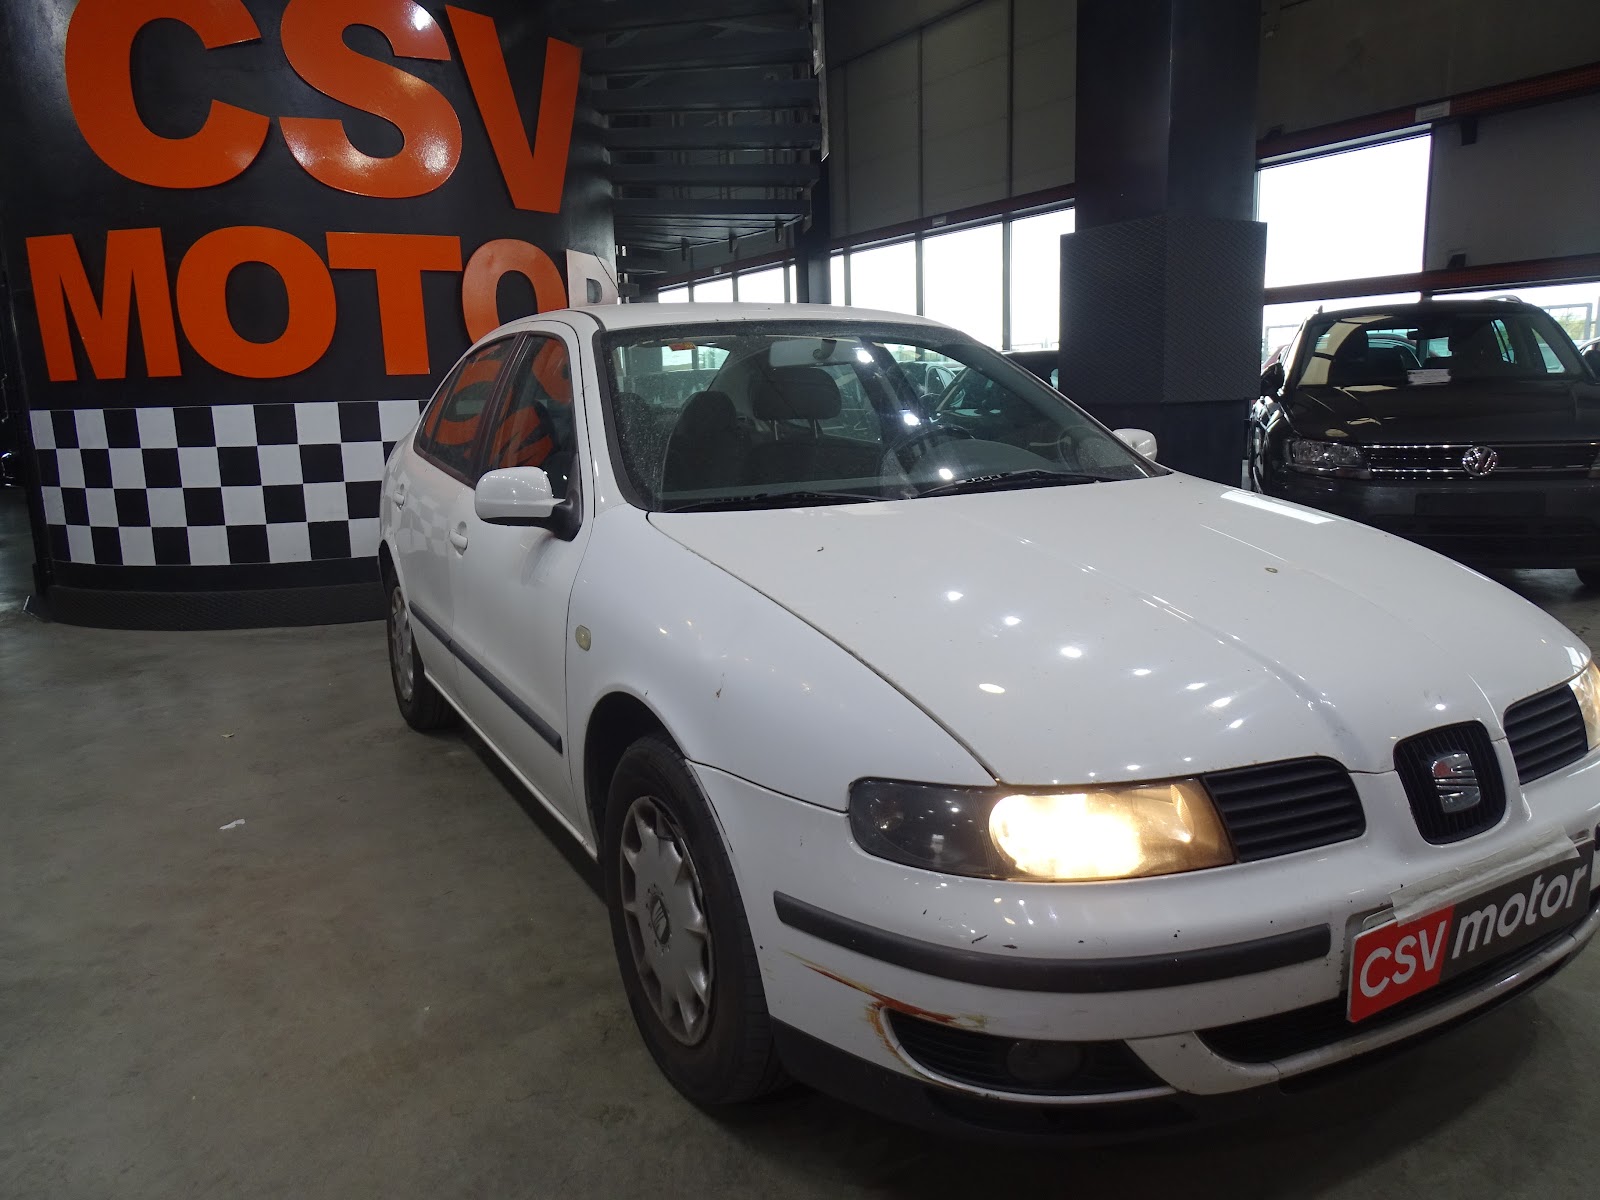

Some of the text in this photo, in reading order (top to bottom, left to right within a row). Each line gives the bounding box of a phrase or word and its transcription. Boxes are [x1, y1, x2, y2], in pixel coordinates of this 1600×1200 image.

[65, 0, 582, 214] CSV
[1359, 864, 1588, 998] CSV motor
